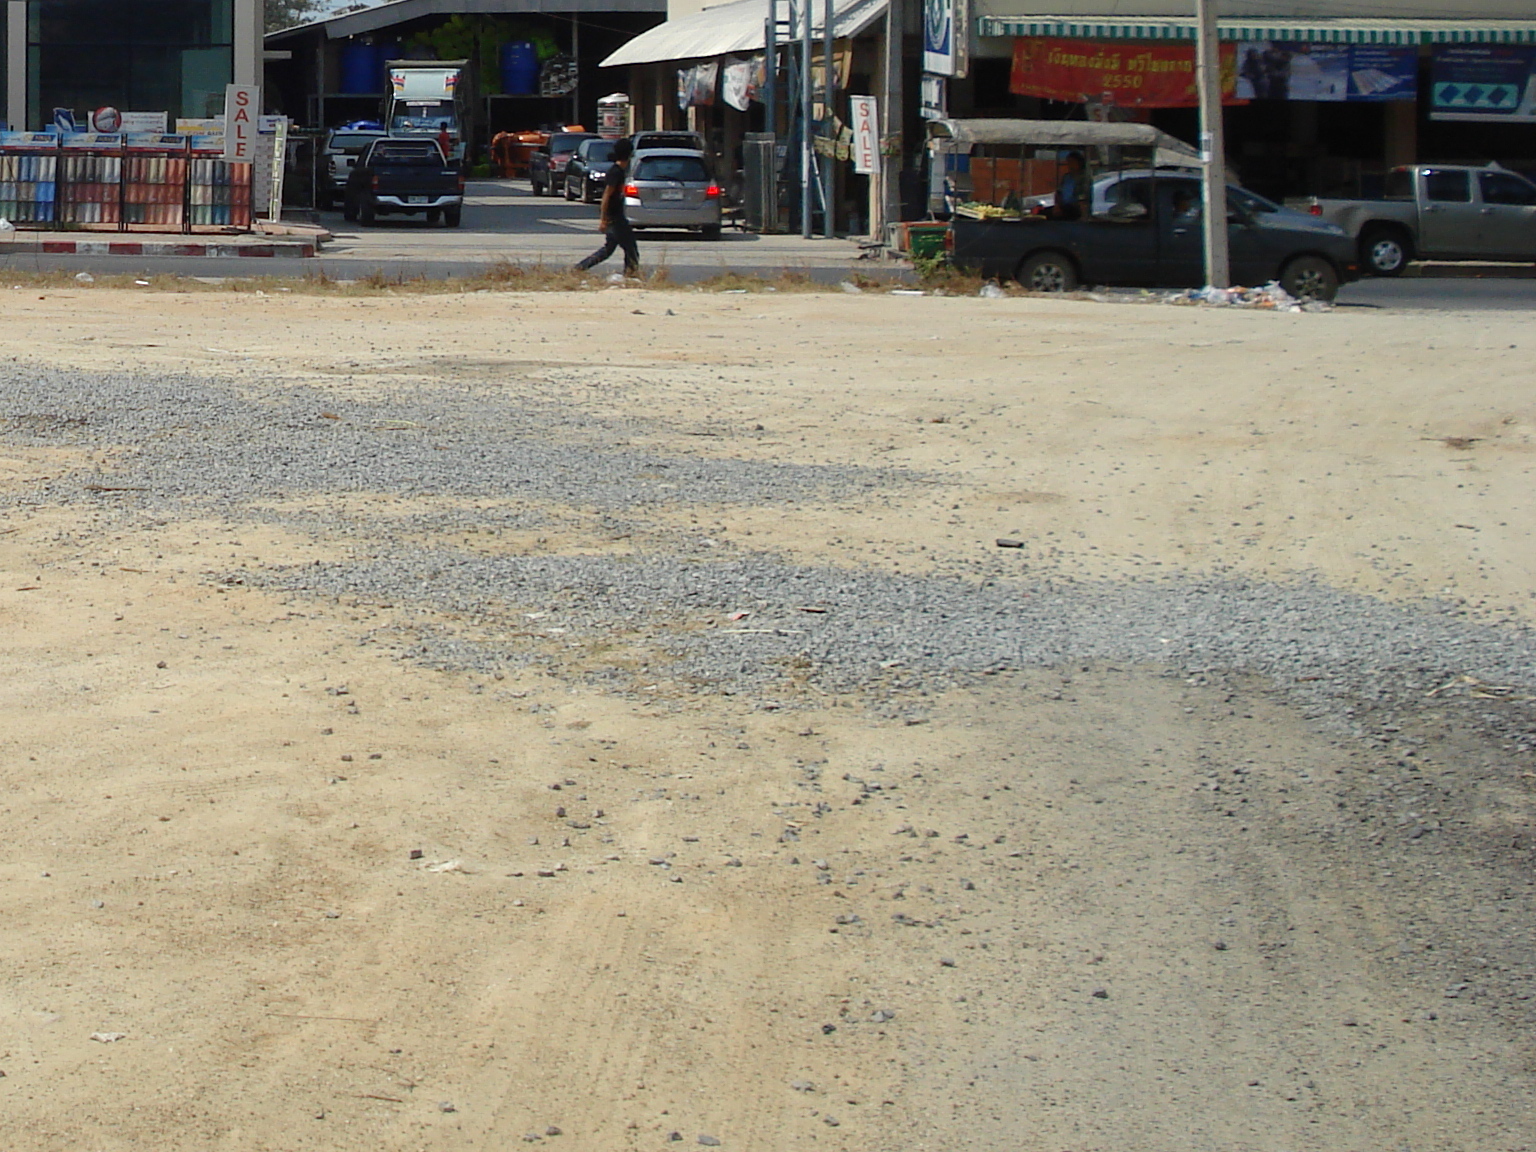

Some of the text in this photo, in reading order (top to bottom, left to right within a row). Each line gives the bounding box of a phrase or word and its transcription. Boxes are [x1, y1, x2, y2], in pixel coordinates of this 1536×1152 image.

[1102, 73, 1143, 89] 2550
[234, 91, 250, 157] SALE
[859, 102, 873, 168] SALE
